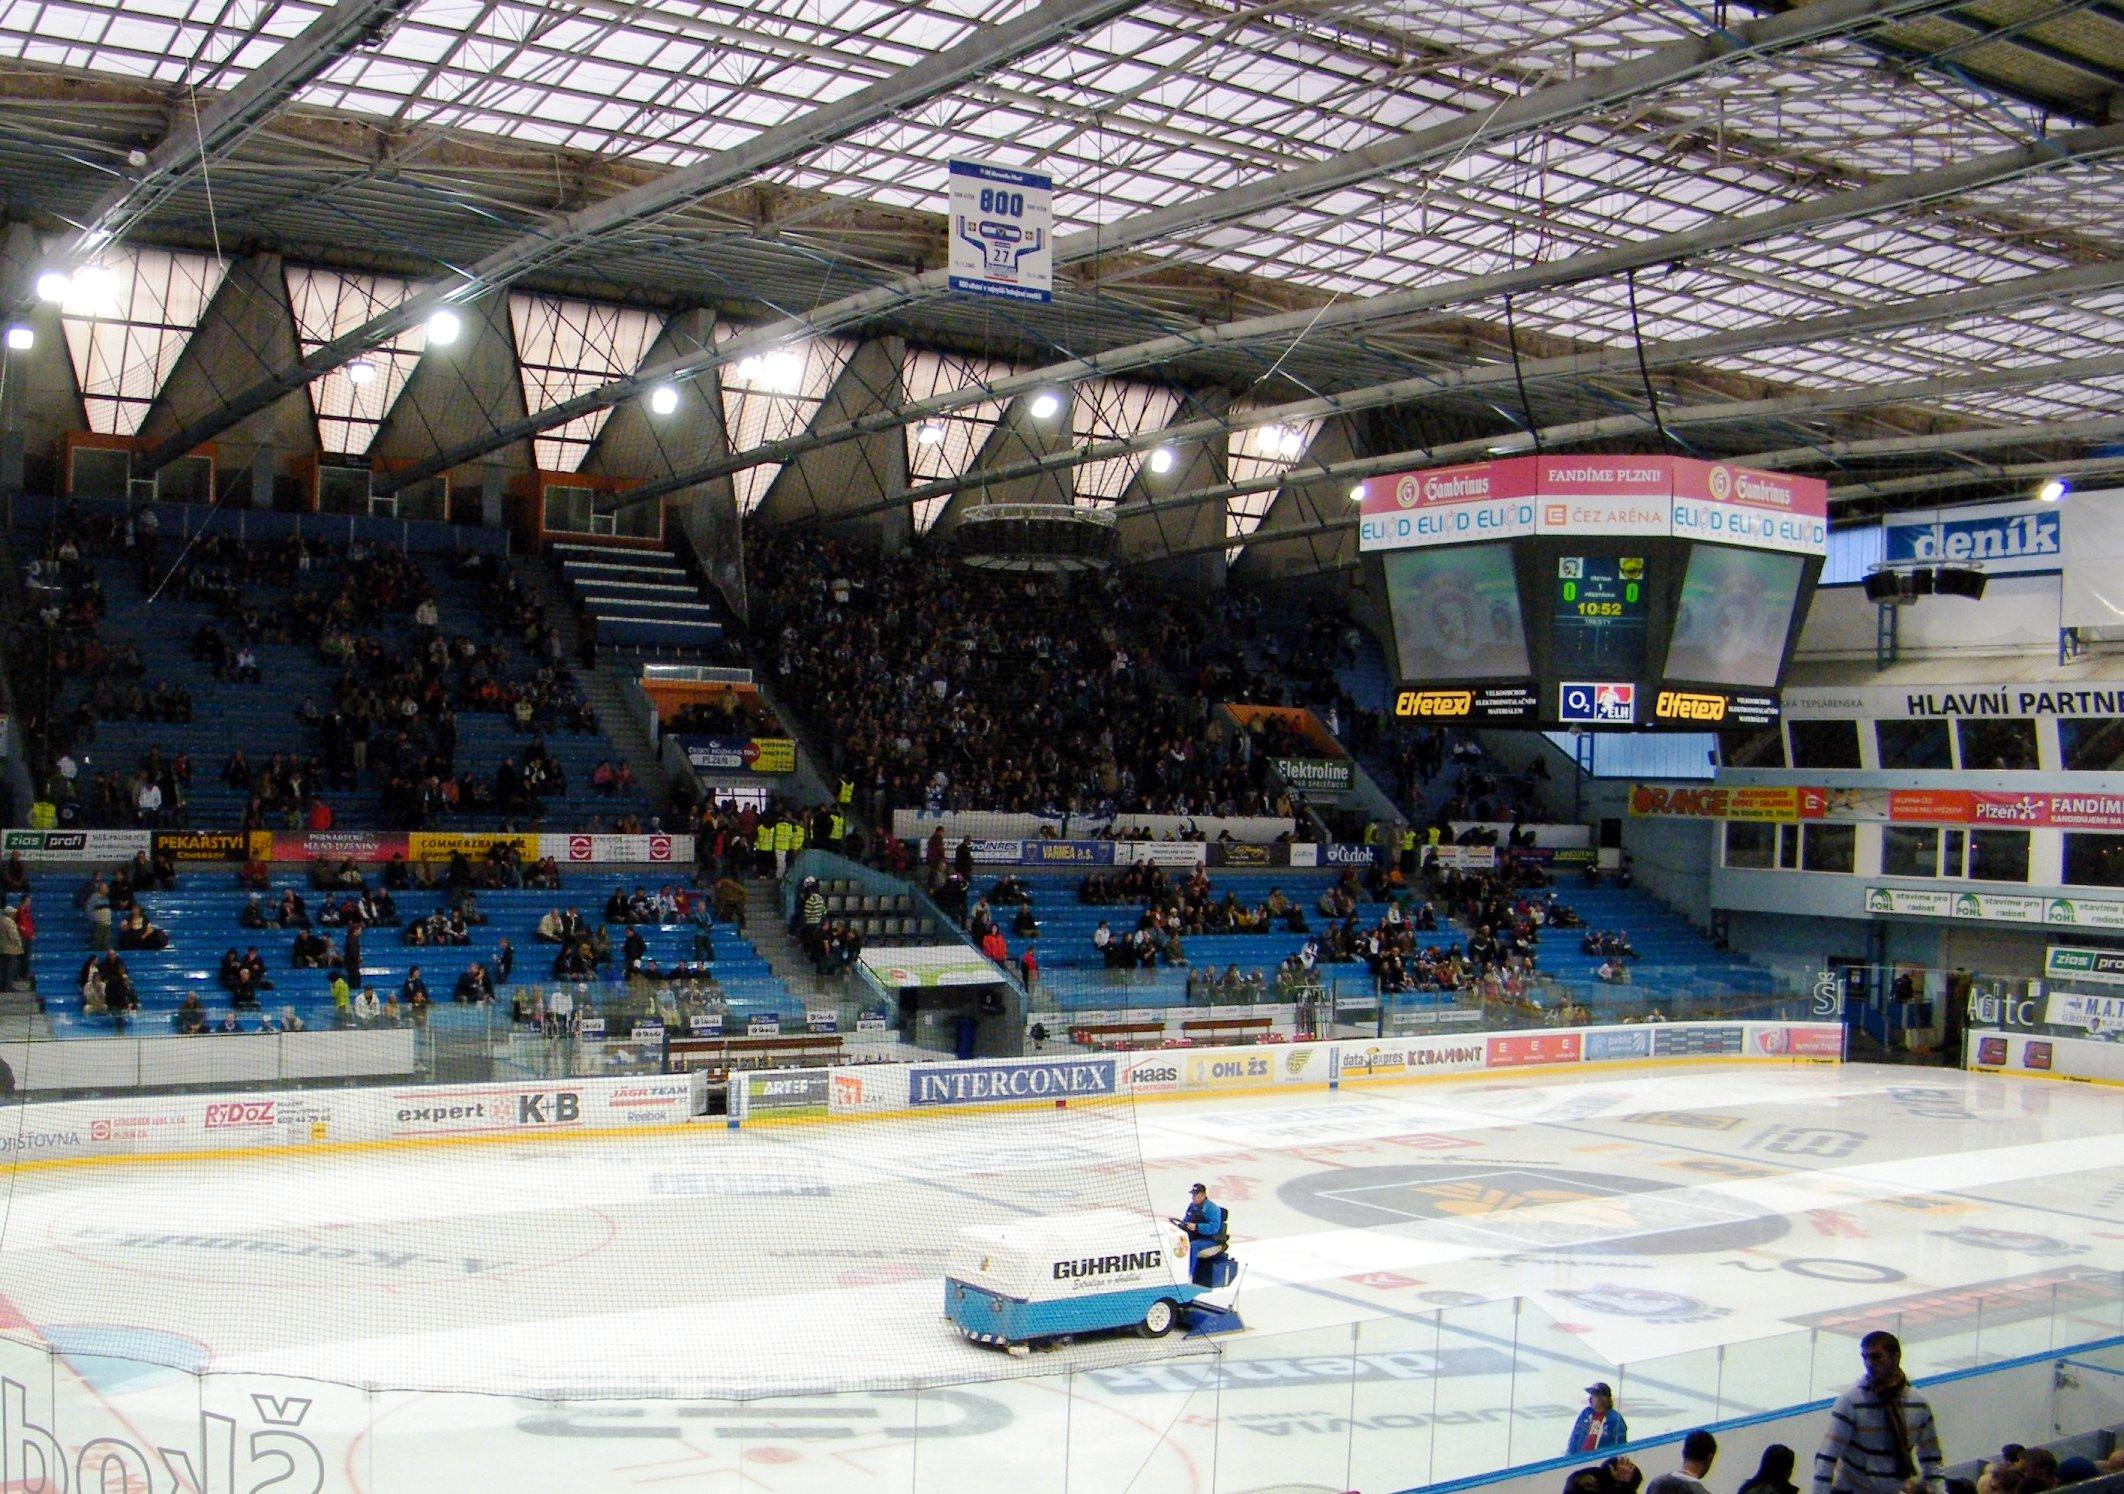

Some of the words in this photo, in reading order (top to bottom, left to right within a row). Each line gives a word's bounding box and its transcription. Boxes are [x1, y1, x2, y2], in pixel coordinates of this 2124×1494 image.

[980, 188, 1023, 218] 800
[993, 248, 1009, 263] 27
[1548, 467, 1614, 482] FANDÍME
[1616, 469, 1661, 482] PLZNI!
[1425, 475, 1489, 501] Gambrinus
[1735, 475, 1791, 505] Gambrinus
[1572, 507, 1602, 523] ČEZ
[1606, 507, 1662, 523] ARÉNA
[1914, 515, 2058, 561] deník
[1563, 581, 1577, 602] 0
[1625, 583, 1639, 603] 0
[1578, 602, 1622, 616] 10:52
[1395, 690, 1472, 717] Elfetex
[1655, 691, 1727, 721] Elfetex
[1907, 686, 2009, 715] HLAVNÍ
[1608, 707, 1630, 719] ELH
[1279, 760, 1349, 781] Elektroline
[1633, 786, 1729, 816] ORANGE
[1976, 801, 2018, 819] Plzeň
[2051, 797, 2124, 813] FANDÍM
[1869, 902, 1895, 911] POHL
[1956, 907, 1982, 917] POHL
[2049, 912, 2077, 922] POHL
[1407, 1046, 1482, 1066] KERAMONT
[1211, 1061, 1244, 1078] OHL
[1247, 1057, 1268, 1076] ŽS
[918, 1064, 1108, 1101] INTERCONEX
[396, 1103, 484, 1123] expert
[519, 1092, 580, 1124] K+B
[1053, 1250, 1161, 1280] GÜHRING
